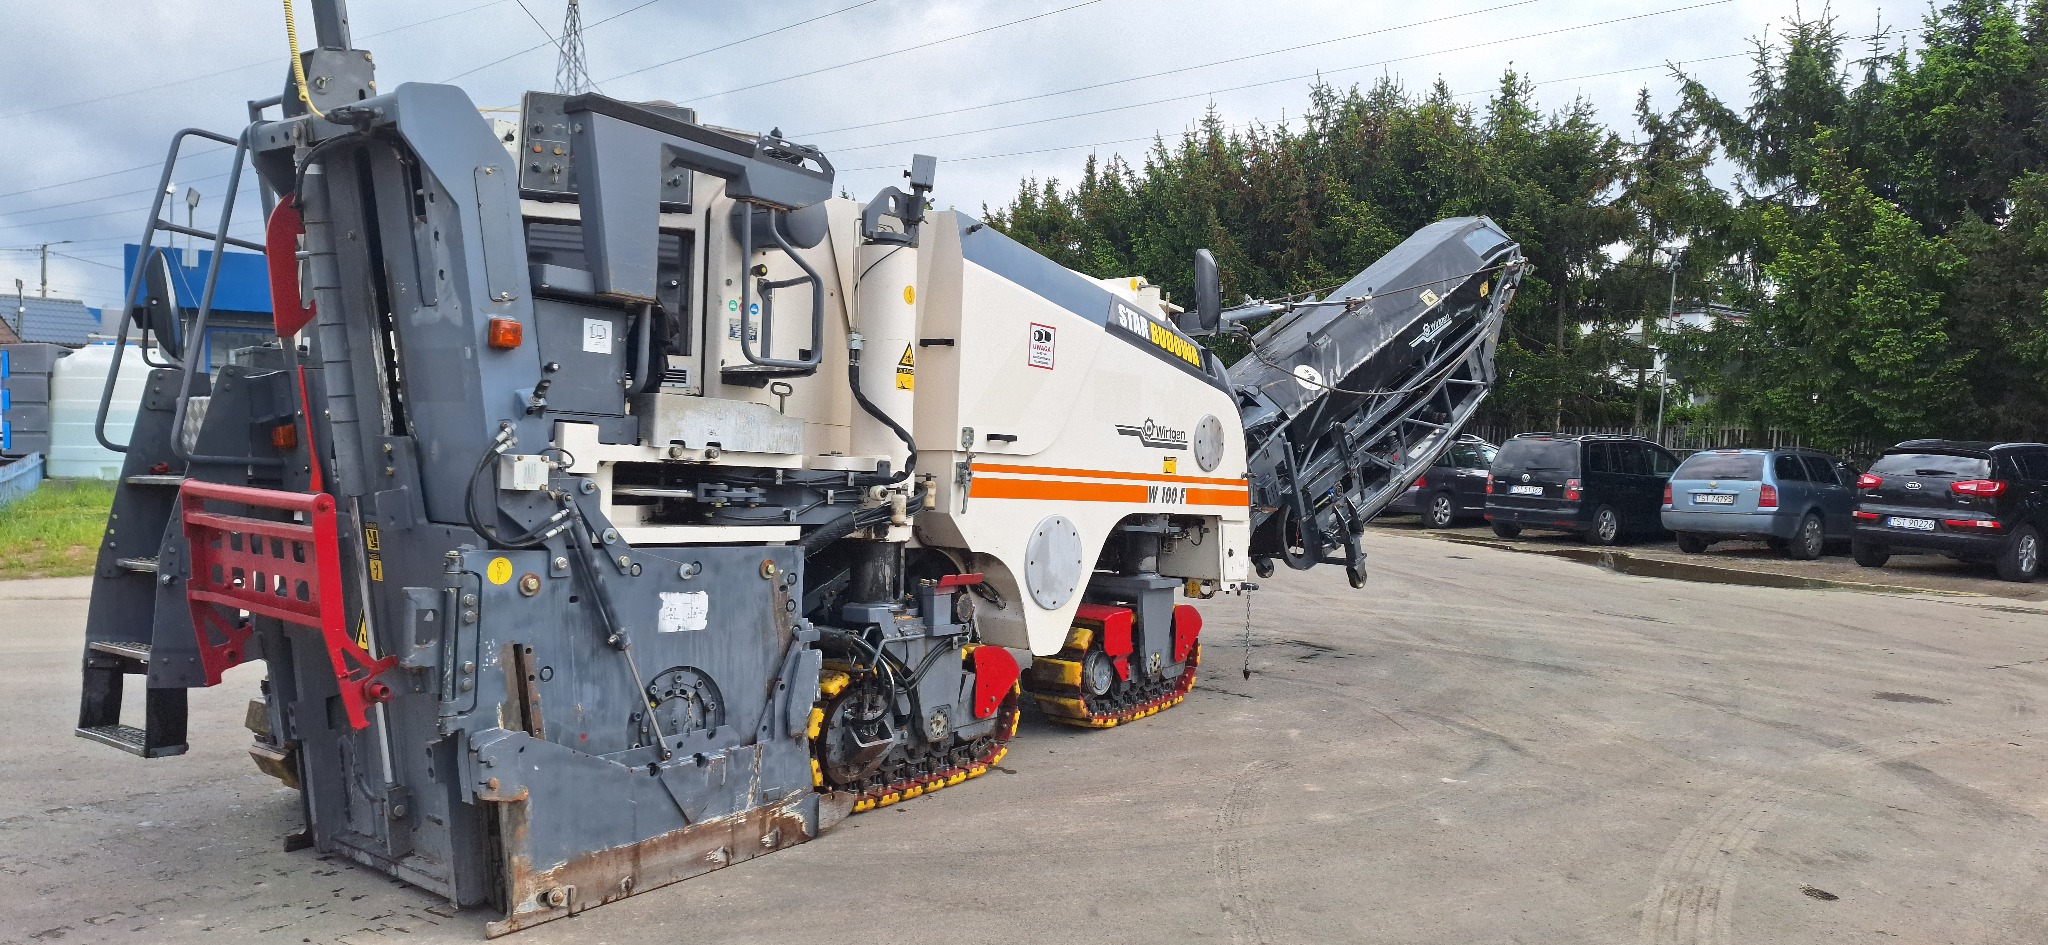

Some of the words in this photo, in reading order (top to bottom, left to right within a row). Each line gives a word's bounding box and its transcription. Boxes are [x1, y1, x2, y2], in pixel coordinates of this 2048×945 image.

[1118, 304, 1150, 340] STAR
[1150, 321, 1201, 368] BUDOWA
[1155, 425, 1186, 443] Wirtgen
[1149, 485, 1159, 504] W
[1161, 486, 1178, 505] 100
[1179, 487, 1186, 505] F
[1697, 494, 1709, 502] TST
[1892, 517, 1907, 526] TST
